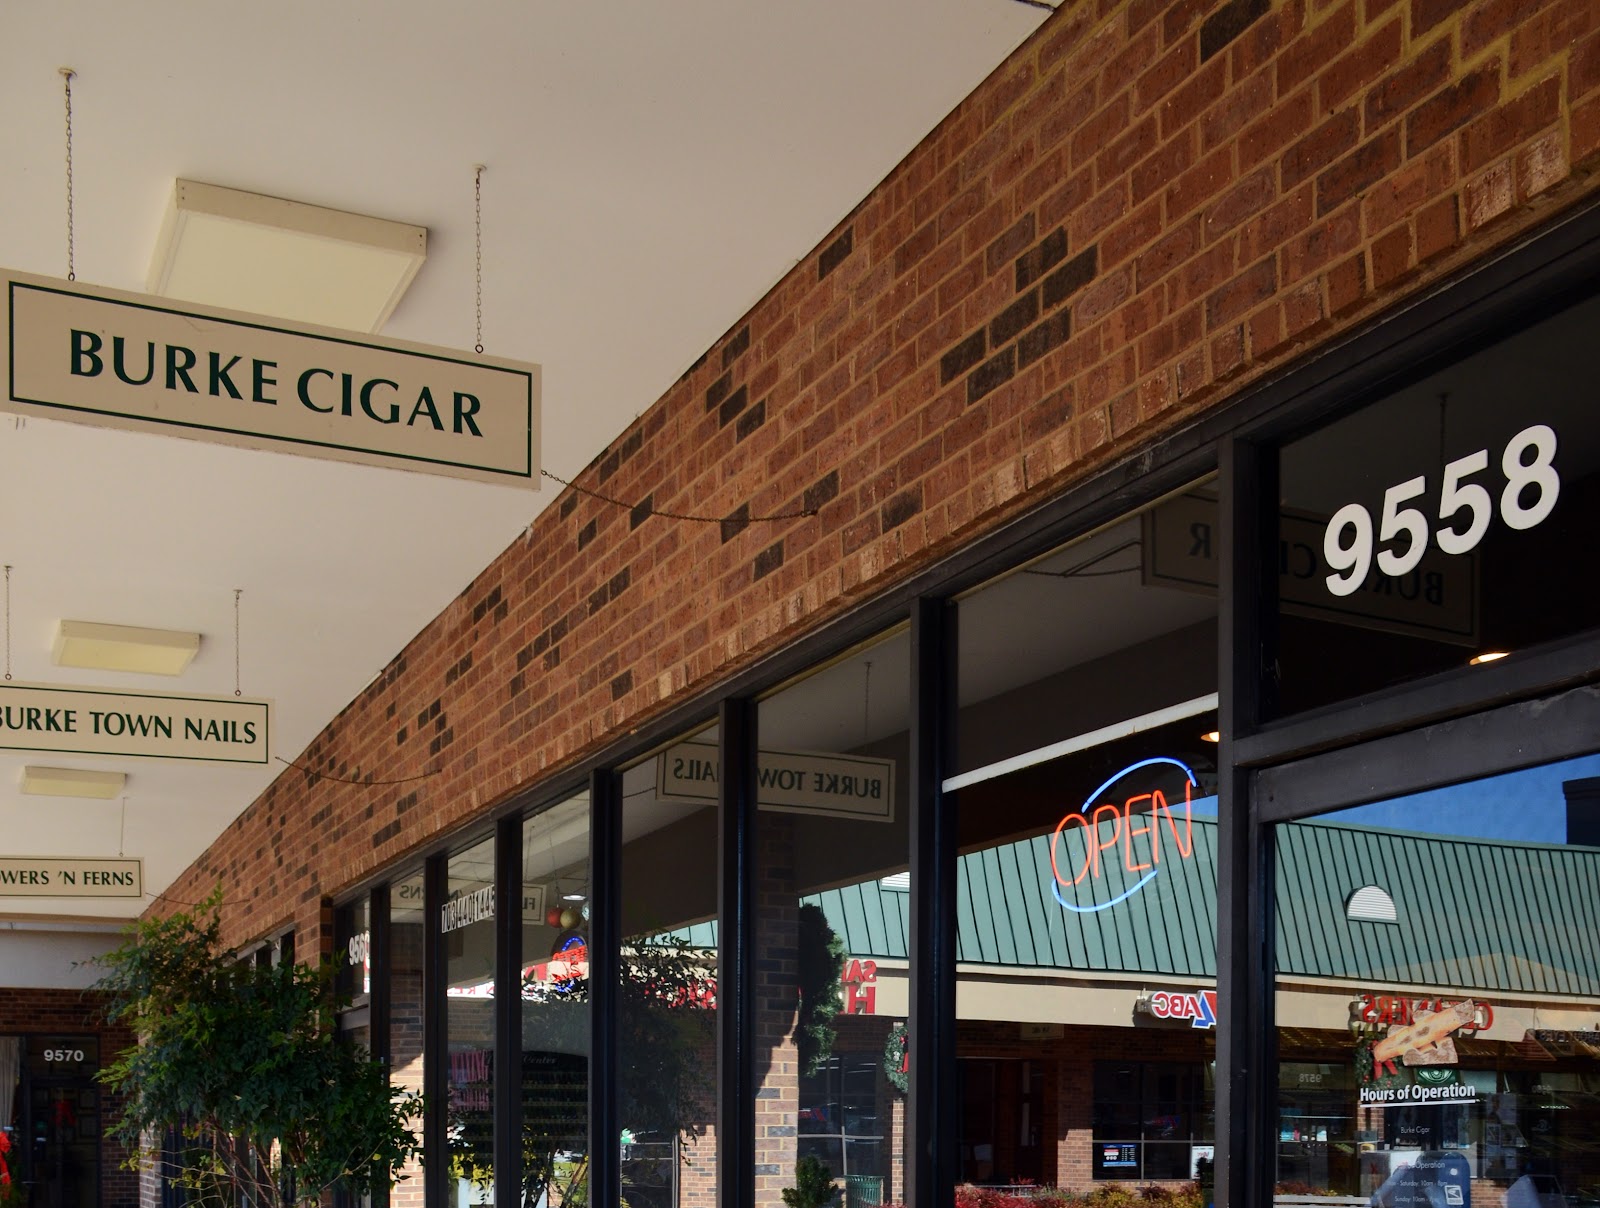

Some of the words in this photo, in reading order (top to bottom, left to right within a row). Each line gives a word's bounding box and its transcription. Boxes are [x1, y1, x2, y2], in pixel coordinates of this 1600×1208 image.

[70, 328, 278, 405] BURKE
[297, 368, 484, 437] CIGAR
[1323, 424, 1561, 597] 9558
[89, 711, 172, 739] TOWN
[184, 717, 257, 744] NAILS
[1050, 779, 1193, 887] OPEN
[0, 870, 50, 885] WERS
[58, 870, 76, 885] 'N
[83, 871, 134, 886] FERNS
[349, 930, 370, 966] 9560
[43, 1049, 84, 1062] 9570
[1360, 1087, 1395, 1102] Hours
[1396, 1085, 1410, 1100] of
[1411, 1082, 1476, 1103] Operation
[1400, 1127, 1415, 1135] Burke
[1415, 1126, 1430, 1135] Cigar
